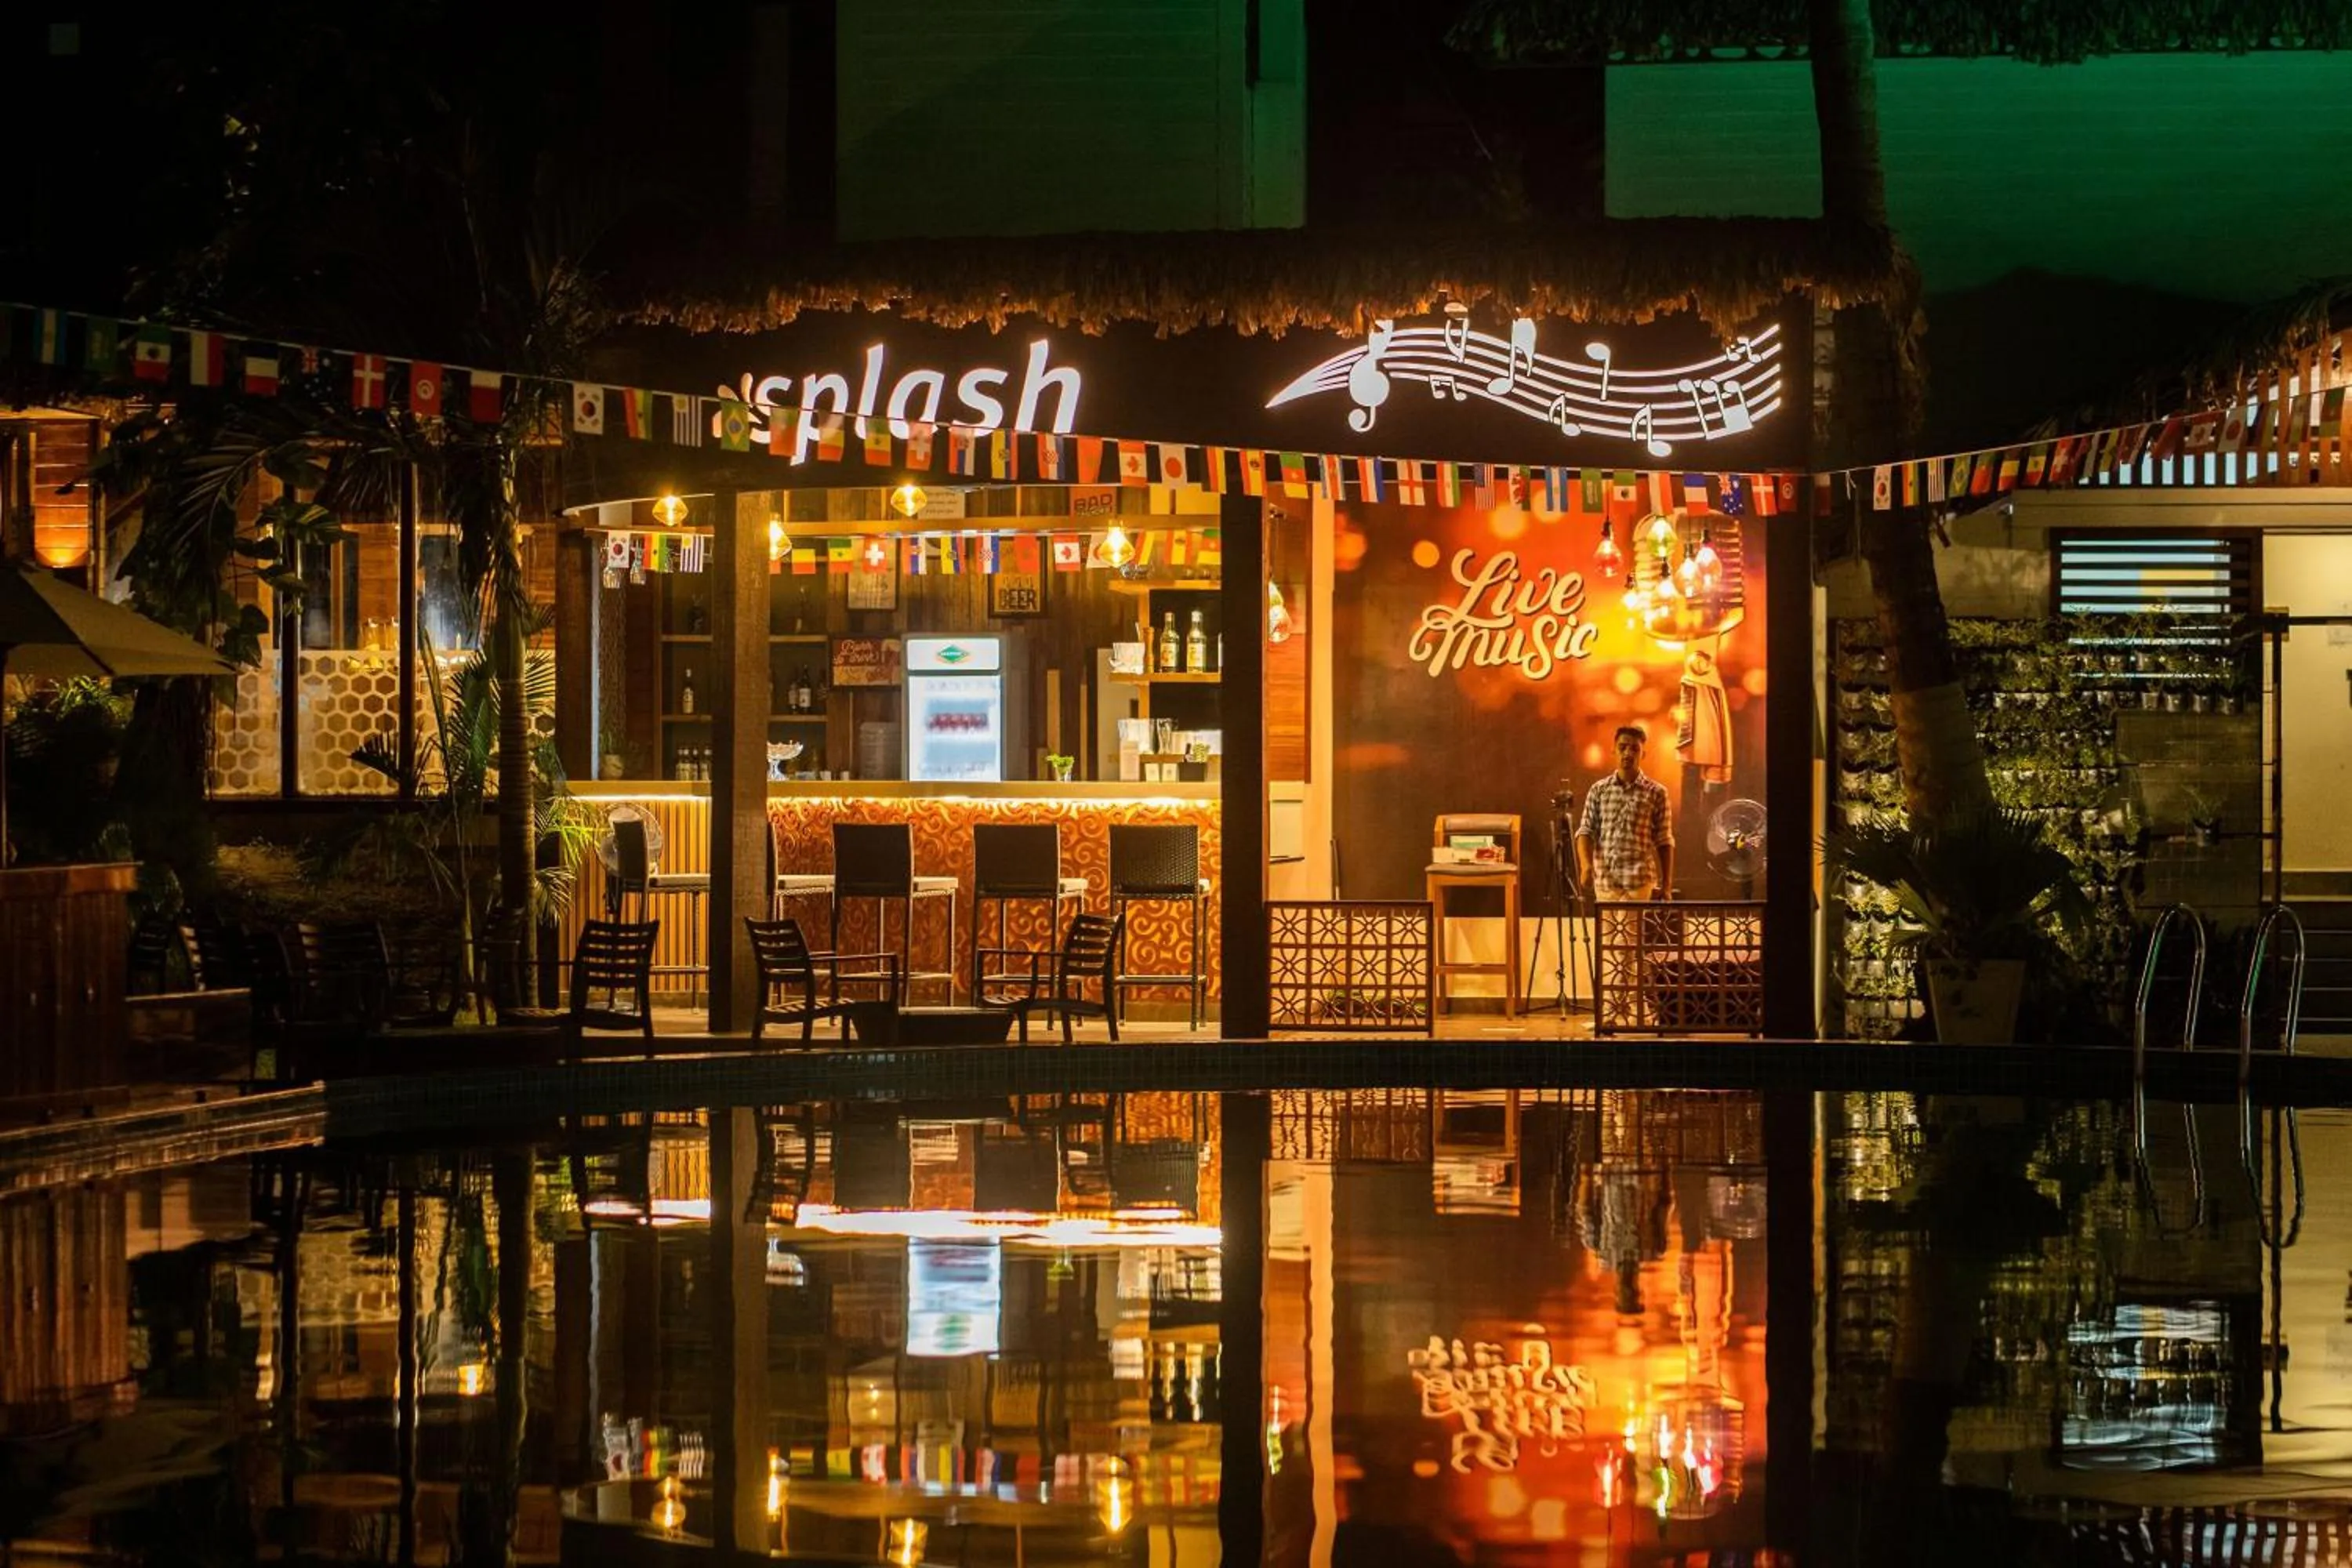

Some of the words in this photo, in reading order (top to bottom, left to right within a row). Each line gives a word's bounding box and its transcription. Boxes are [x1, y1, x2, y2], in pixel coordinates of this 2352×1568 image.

[750, 339, 1081, 466] splash
[999, 589, 1037, 610] BEER
[1422, 548, 1586, 628] Live
